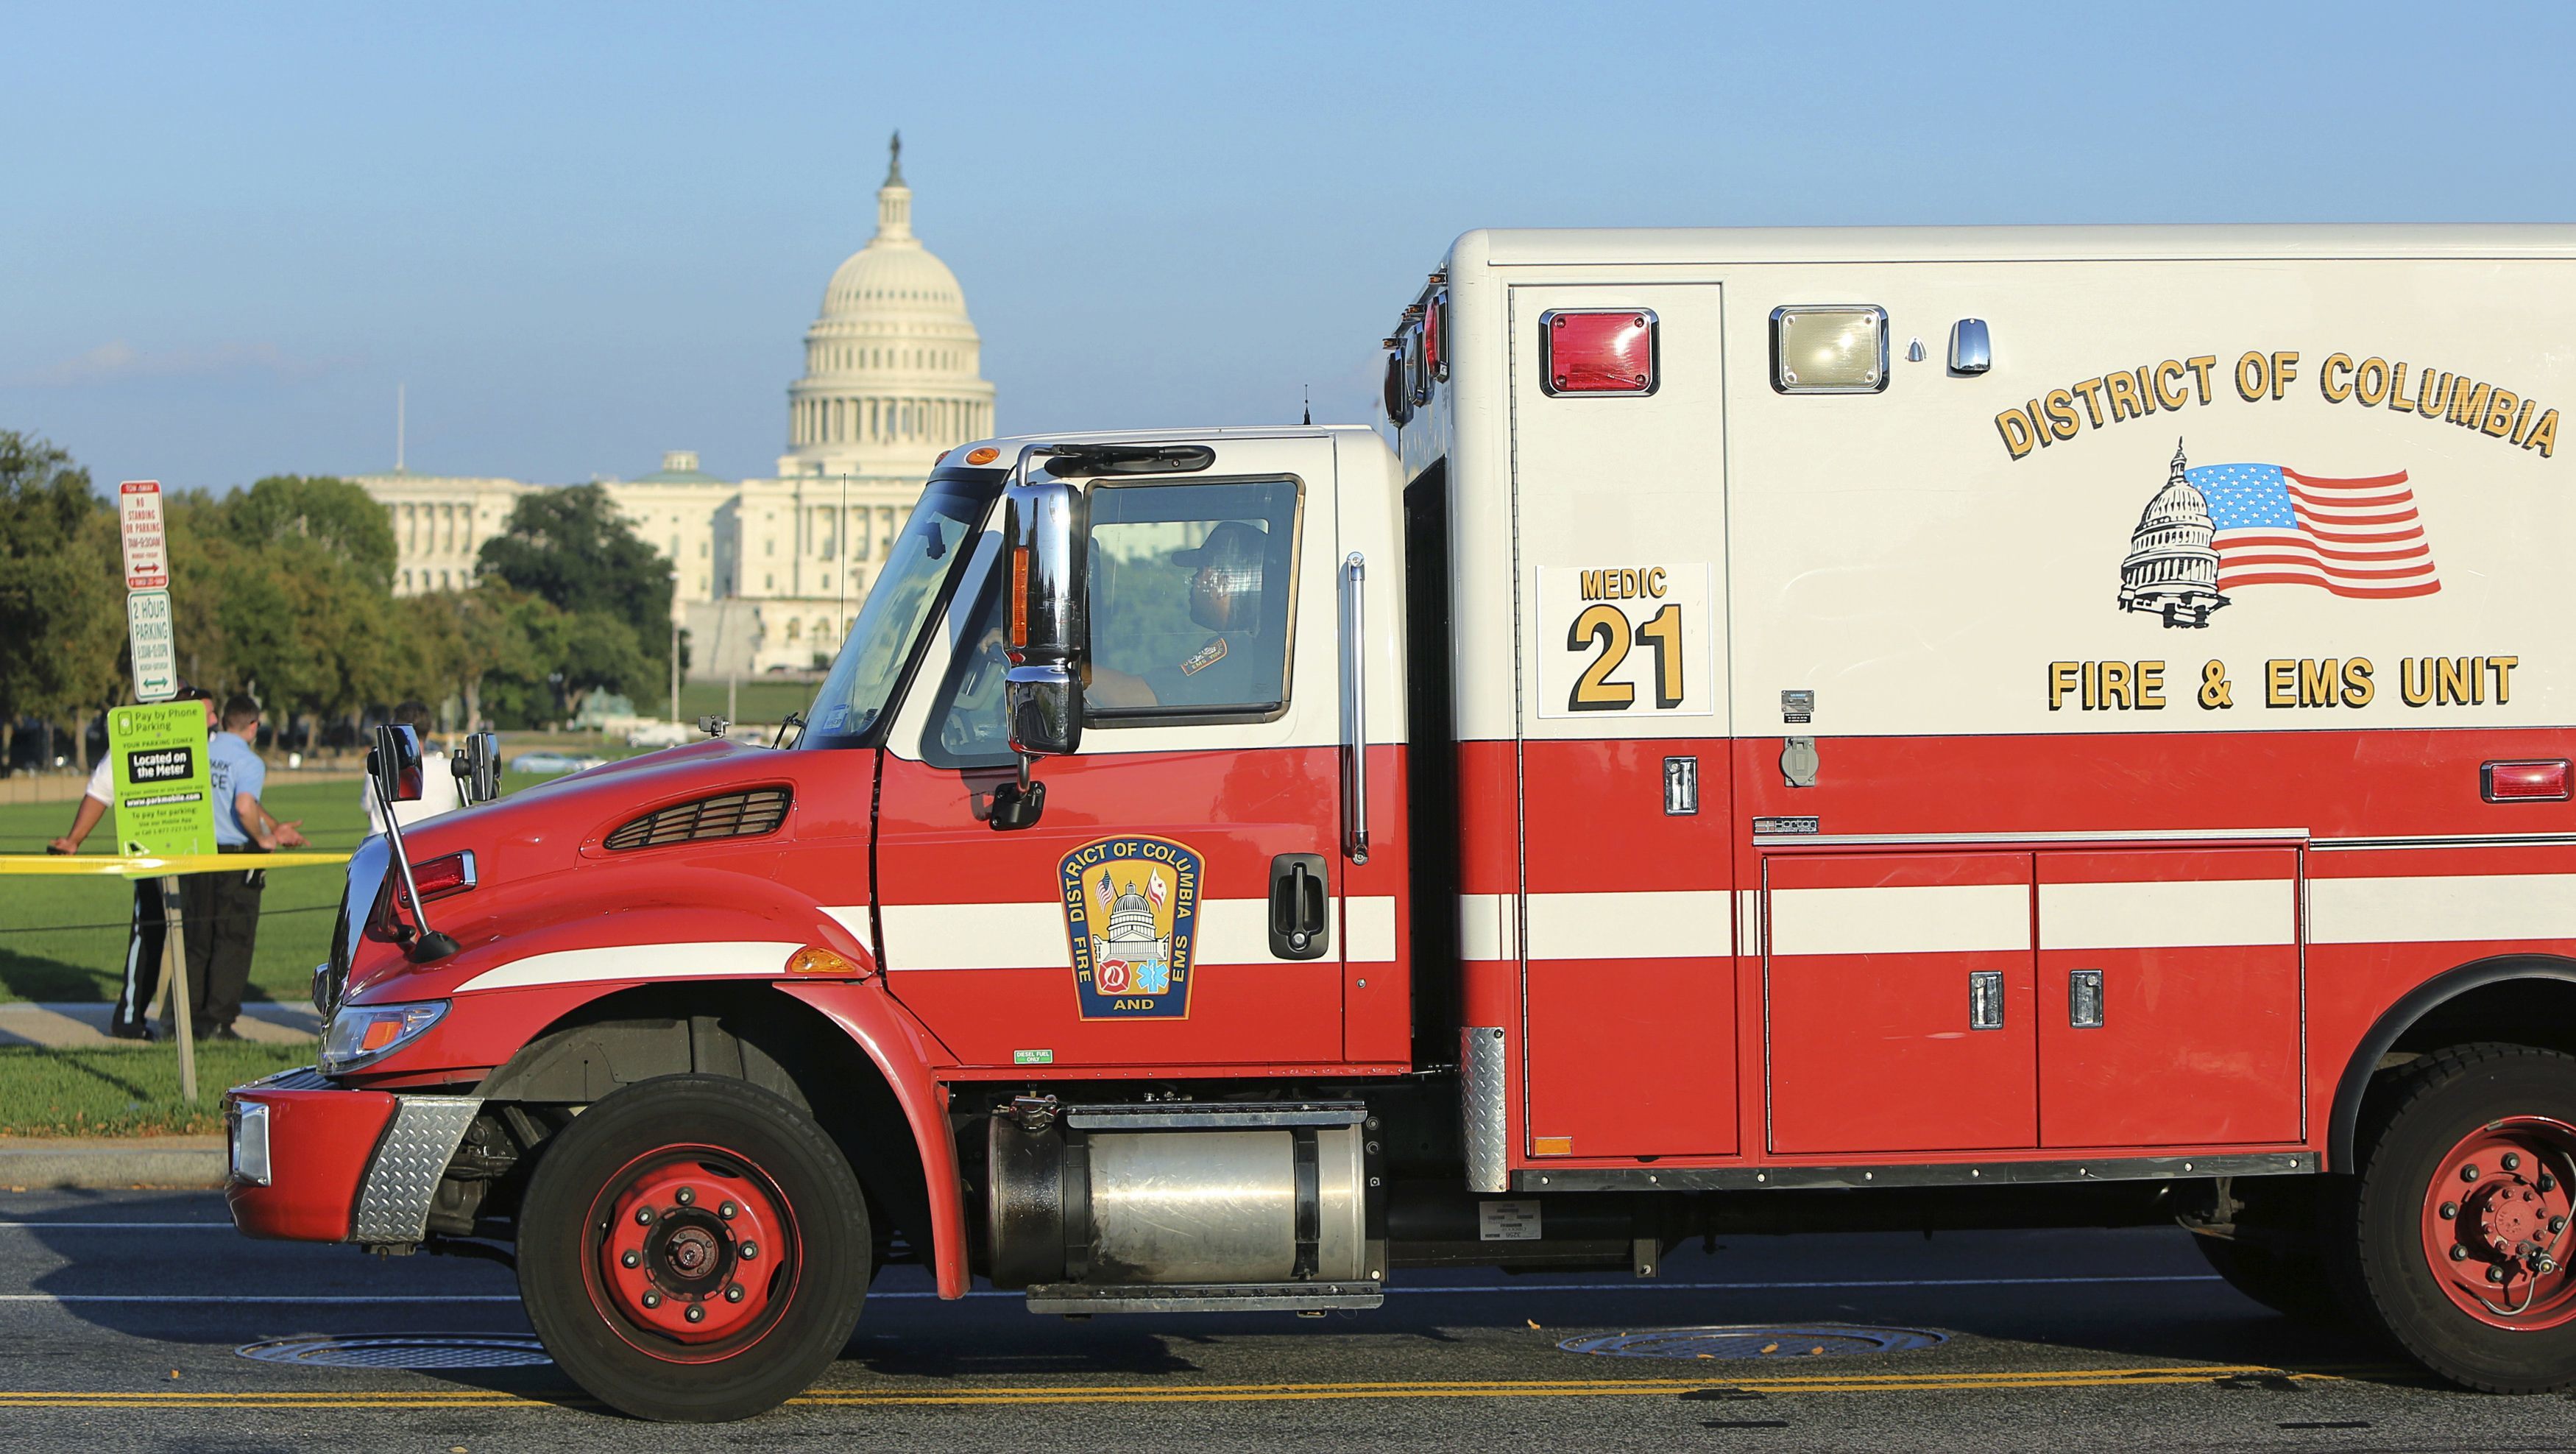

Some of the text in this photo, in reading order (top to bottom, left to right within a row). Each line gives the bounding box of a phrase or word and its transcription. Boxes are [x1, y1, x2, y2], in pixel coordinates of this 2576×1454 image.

[1995, 350, 2560, 461] DISTRICT OF COLUMBIA
[136, 497, 144, 507] NO
[128, 509, 155, 520] STANDING
[126, 522, 160, 534] OR PARKING
[1580, 566, 1667, 601] MEDIC
[133, 600, 166, 618] 2 HOUR
[135, 621, 168, 640] PARKING
[1567, 604, 1684, 711] 21
[2048, 655, 2519, 711] FIRE & EMS UNIT
[135, 708, 197, 721] Pay by Phone
[136, 722, 171, 732] Parking
[142, 739, 171, 747] PARKING
[133, 751, 187, 767] Located on
[210, 758, 230, 772] ARK
[137, 763, 185, 779] the Meter
[126, 793, 201, 807] www.parkmobile.com
[142, 812, 155, 820] pay
[1775, 819, 1817, 828] Horton
[1066, 841, 1194, 922] DISTRICT OF COLUMBIA
[1074, 936, 1091, 983] FIRE
[1172, 935, 1188, 983] EMS
[1114, 999, 1155, 1010] AND
